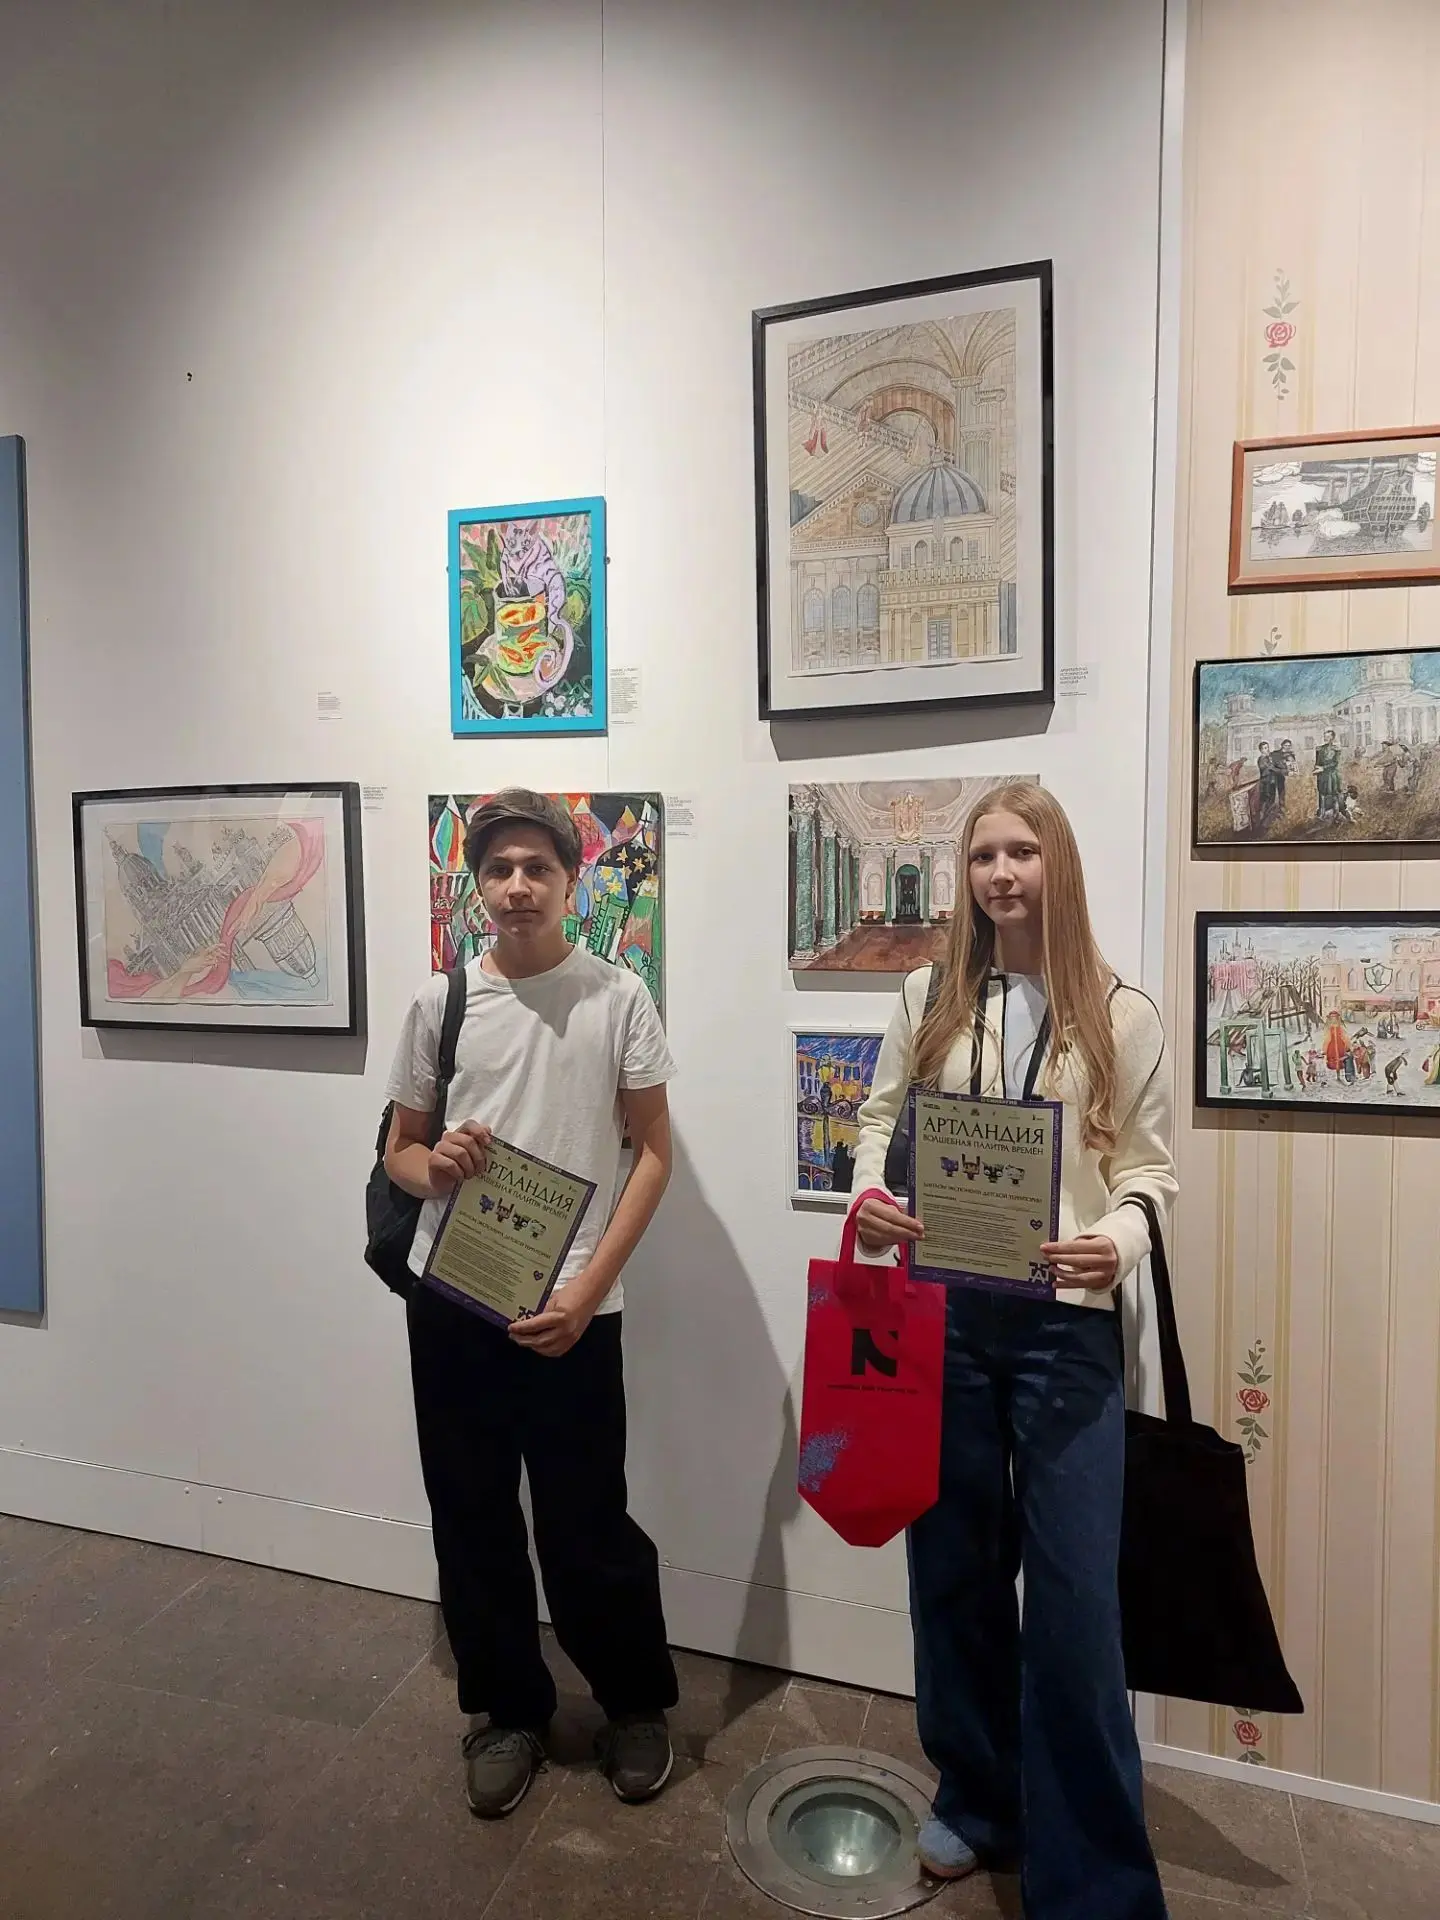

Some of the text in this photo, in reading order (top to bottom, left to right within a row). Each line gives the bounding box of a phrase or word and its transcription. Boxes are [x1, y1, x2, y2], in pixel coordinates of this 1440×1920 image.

[923, 1115, 1045, 1145] АРТЛАНДИЯ
[922, 1133, 972, 1147] ВОЛШЕБНАЯ
[974, 1141, 1010, 1153] ПАЛИТРА
